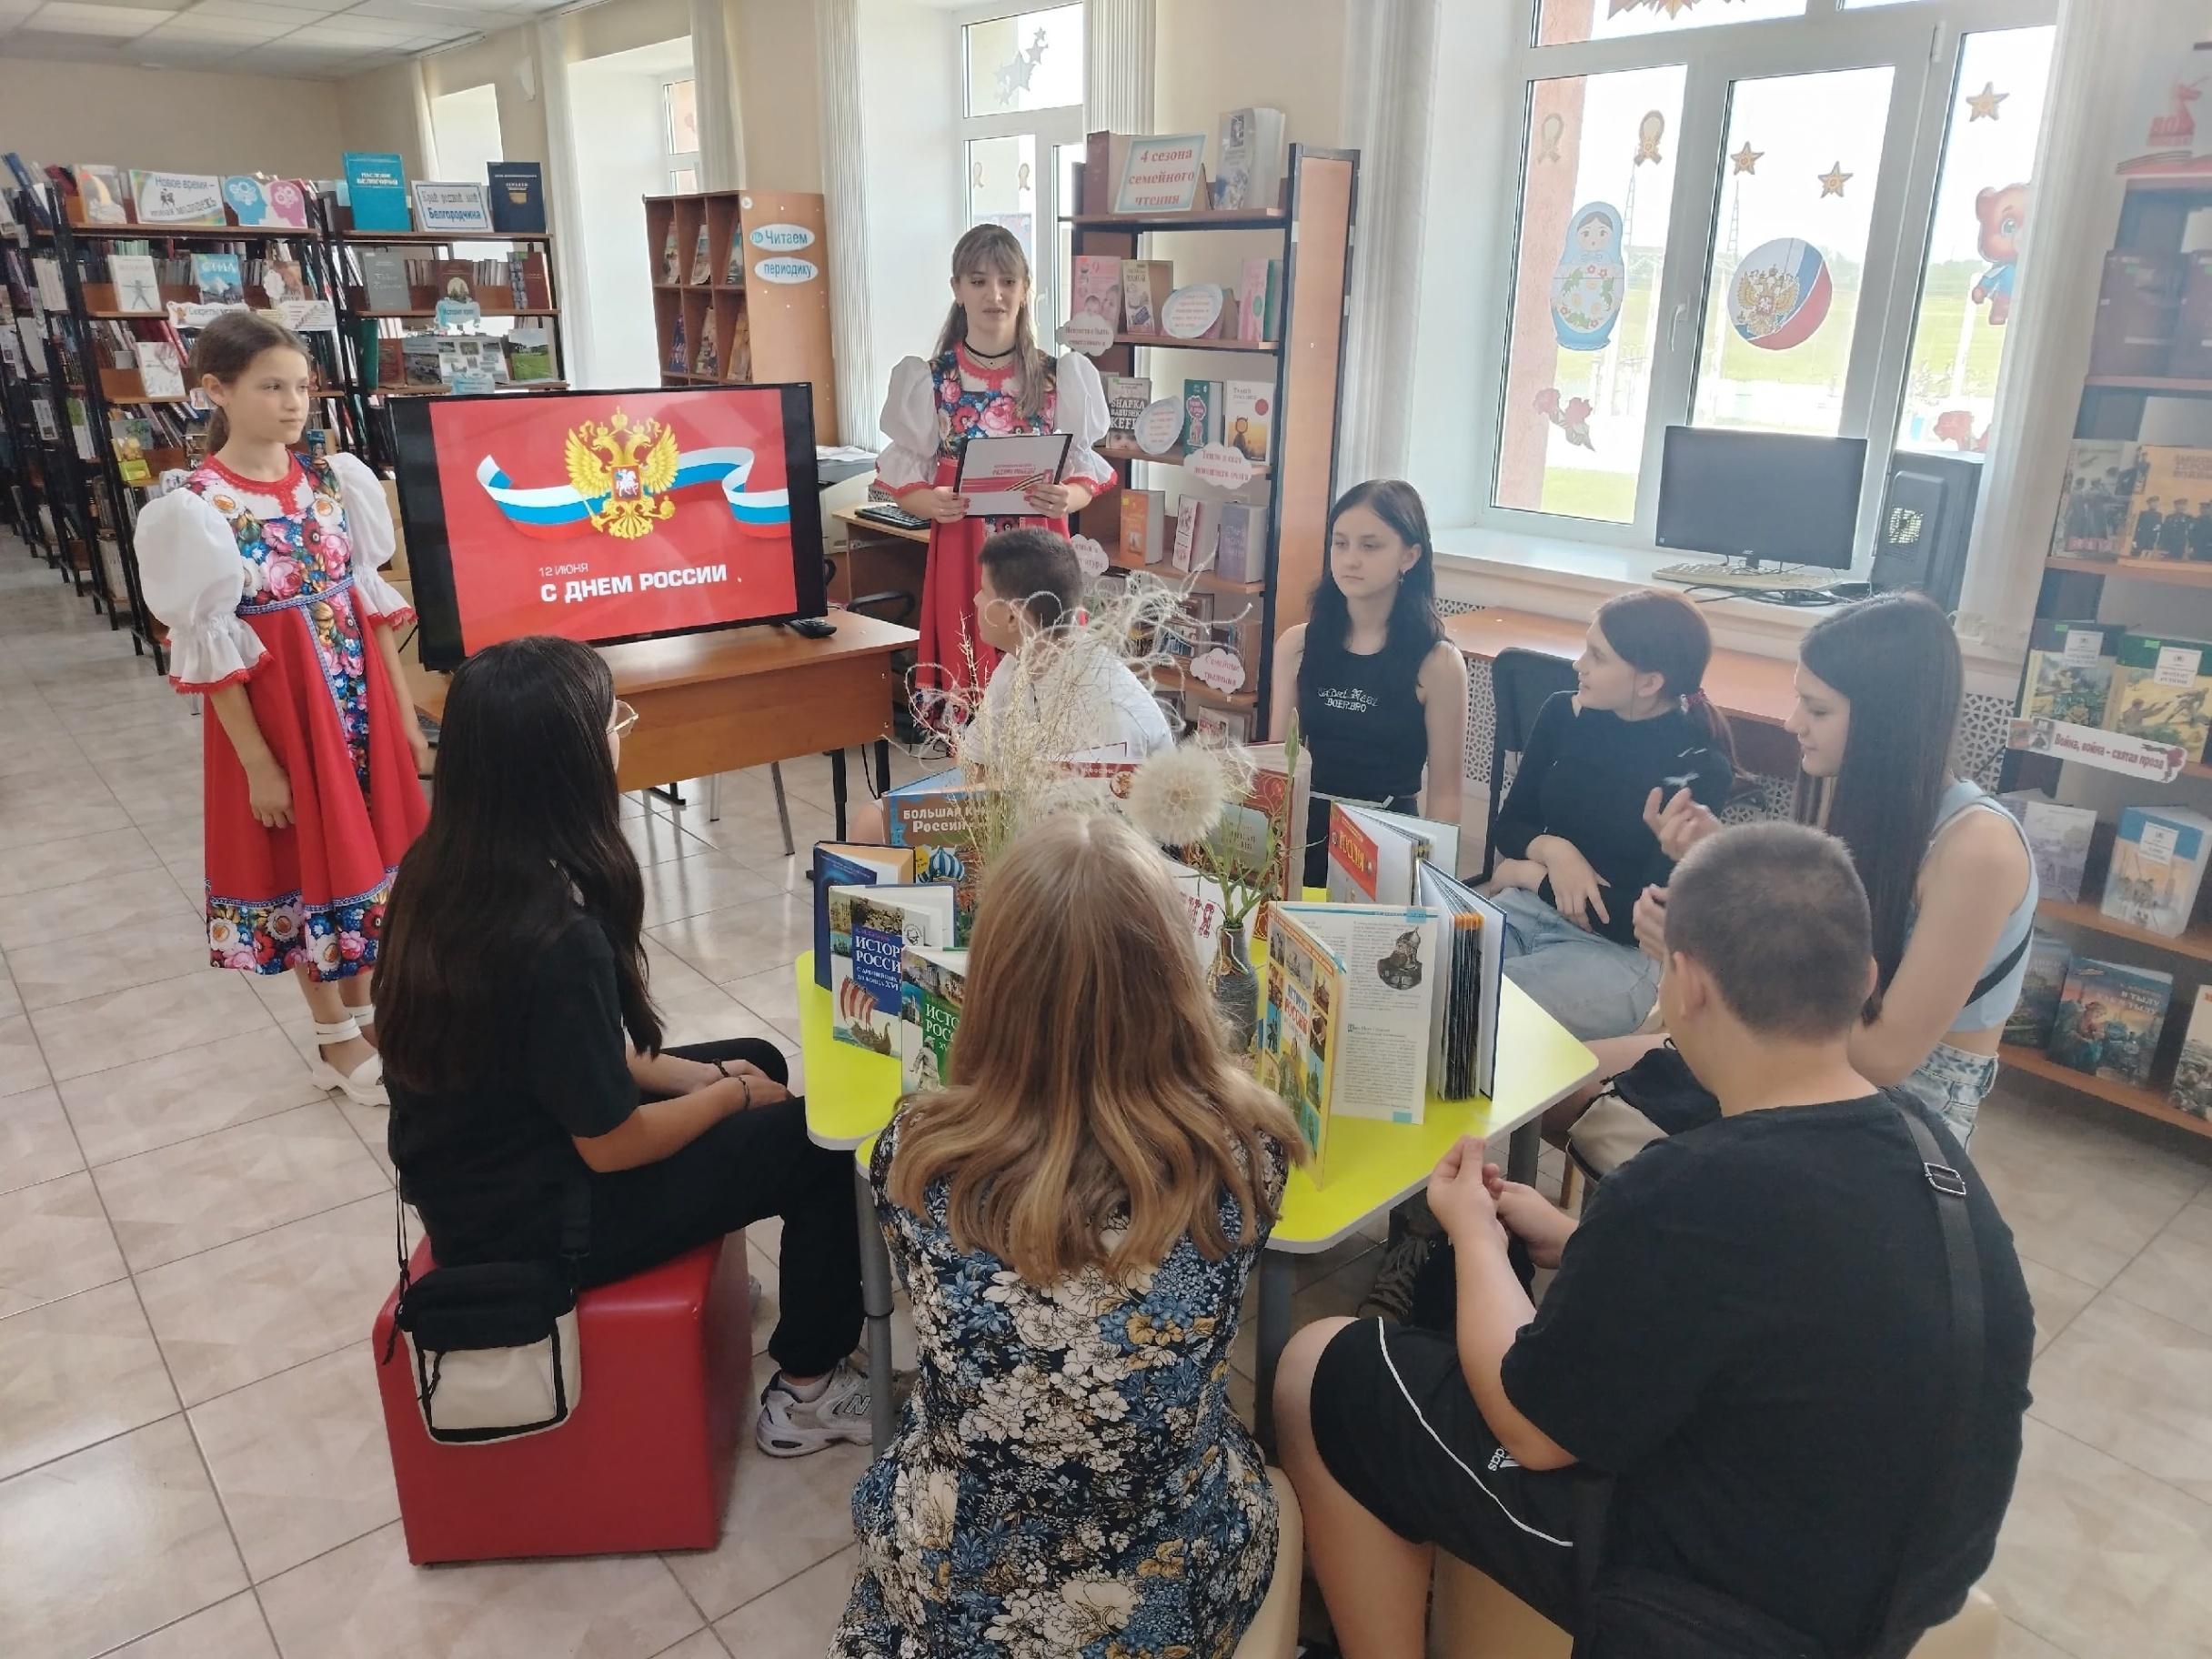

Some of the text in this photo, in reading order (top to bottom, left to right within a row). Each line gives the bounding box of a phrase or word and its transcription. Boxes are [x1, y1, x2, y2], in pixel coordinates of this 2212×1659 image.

[1140, 148, 1193, 162] 4 сезона
[1128, 170, 1195, 186] семейного
[1134, 194, 1181, 206] чтения
[427, 206, 482, 222] Белгородчина
[765, 229, 809, 246] Читаем
[763, 262, 812, 278] периодику
[1111, 399, 1145, 409] SHAPKA
[1111, 408, 1141, 417] BABUSHK
[1111, 417, 1136, 430] KEFI
[538, 562, 589, 578] 12 ИЮНЯ
[540, 564, 728, 604] С ДНЕМ РОССИИ
[2055, 733, 2080, 752] Война,
[2081, 741, 2106, 756] война
[2112, 749, 2139, 764] святая
[2138, 755, 2165, 769] проза
[903, 806, 963, 820] БОЛЬШАЯ
[855, 935, 901, 958] ИСТОР
[855, 950, 902, 974] РОССИ
[925, 1003, 960, 1030] ИСТО
[925, 1019, 952, 1042] РОС
